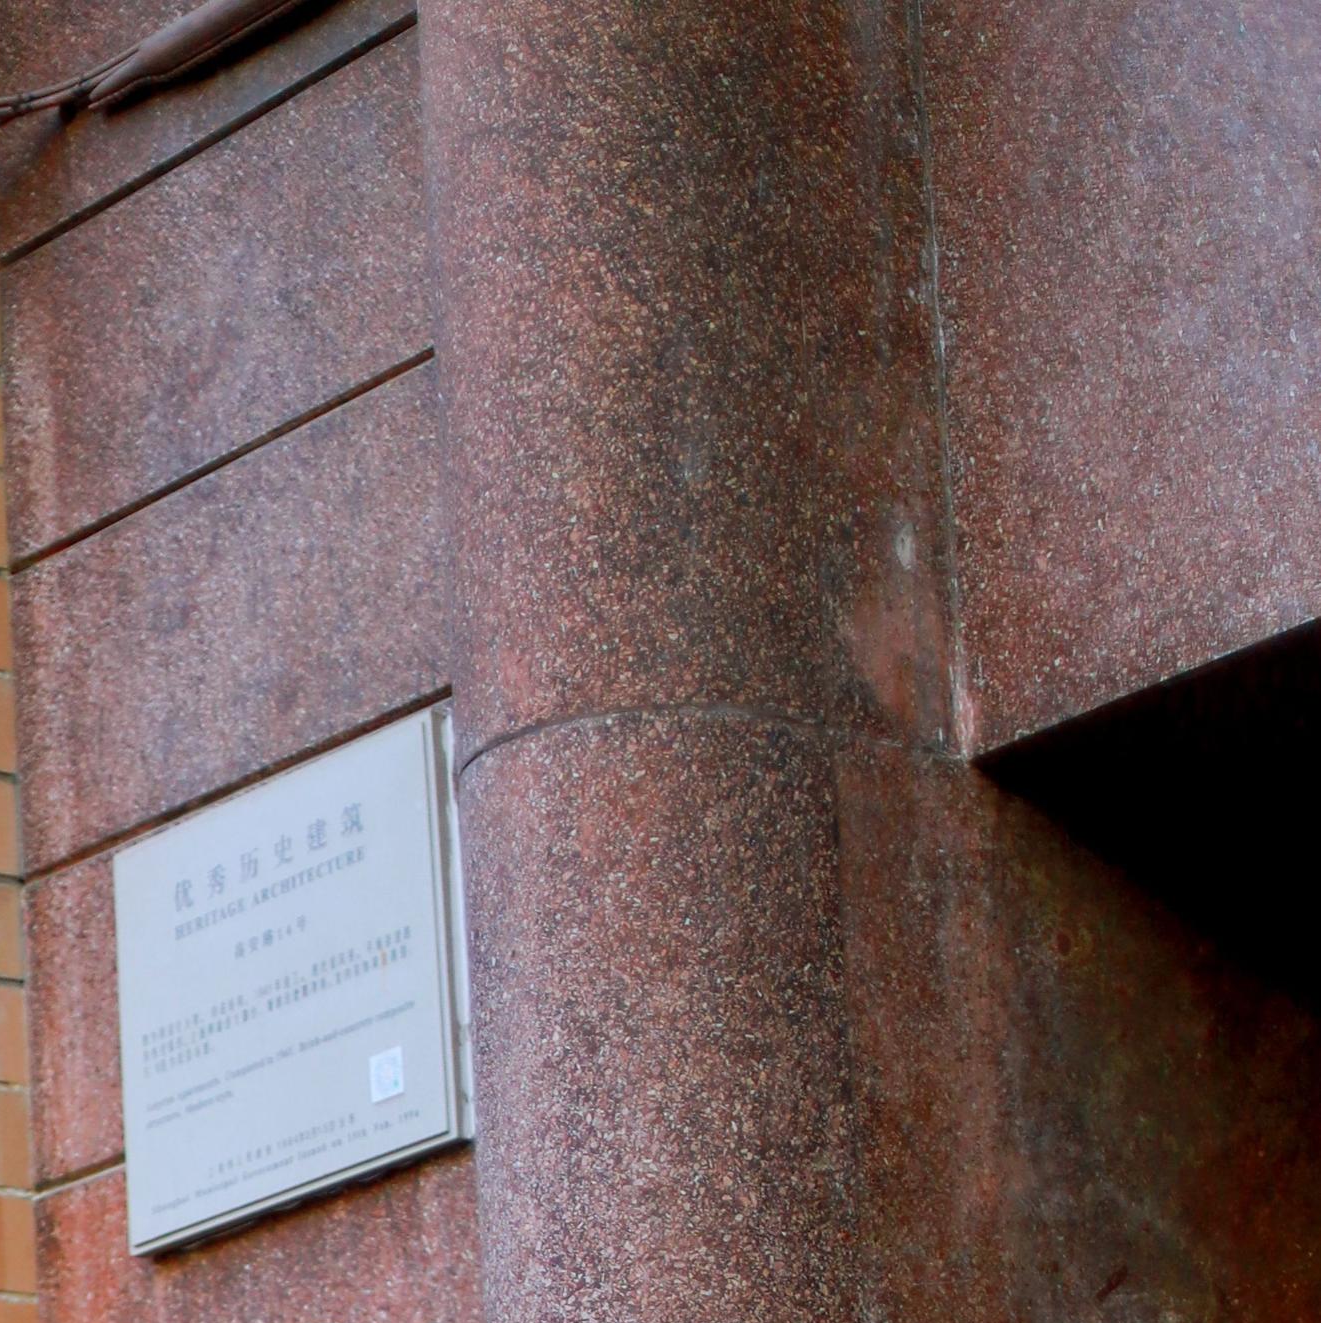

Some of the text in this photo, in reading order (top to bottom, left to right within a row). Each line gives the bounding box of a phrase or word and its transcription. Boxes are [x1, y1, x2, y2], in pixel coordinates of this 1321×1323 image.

[174, 802, 365, 912] 优秀历史建筑
[175, 845, 367, 941] HERITAGE ARCHITECTURE
